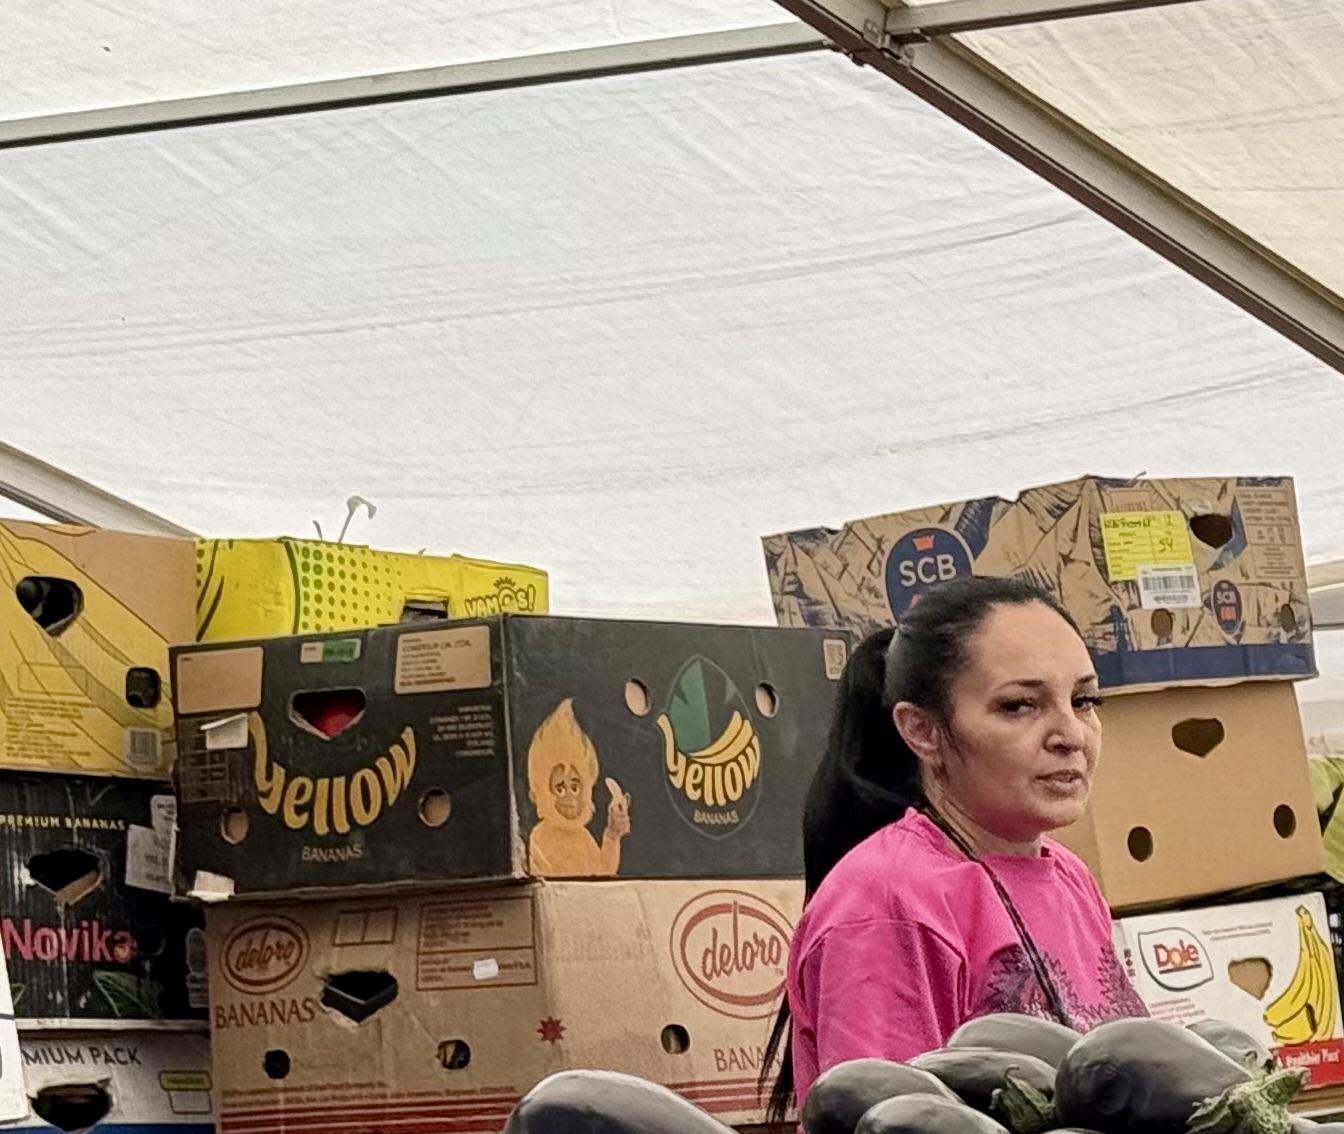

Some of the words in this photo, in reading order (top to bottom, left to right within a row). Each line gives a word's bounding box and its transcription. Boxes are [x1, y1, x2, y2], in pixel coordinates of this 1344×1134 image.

[900, 554, 957, 587] SCB
[464, 584, 536, 618] VAMOS!
[1216, 591, 1237, 604] SCB
[250, 711, 416, 836] yellow
[657, 714, 760, 806] yellow
[0, 814, 60, 829] PREMIUM
[65, 817, 126, 831] BANANAS
[694, 809, 739, 824] BANANAS
[302, 845, 363, 862] BANANAS
[0, 918, 136, 963] Novika
[236, 929, 296, 972] deloro
[701, 901, 782, 981] deloro
[1153, 939, 1200, 968] Dole
[215, 998, 316, 1029] BANANAS
[20, 1046, 85, 1066] MIUM
[88, 1046, 142, 1066] PACK
